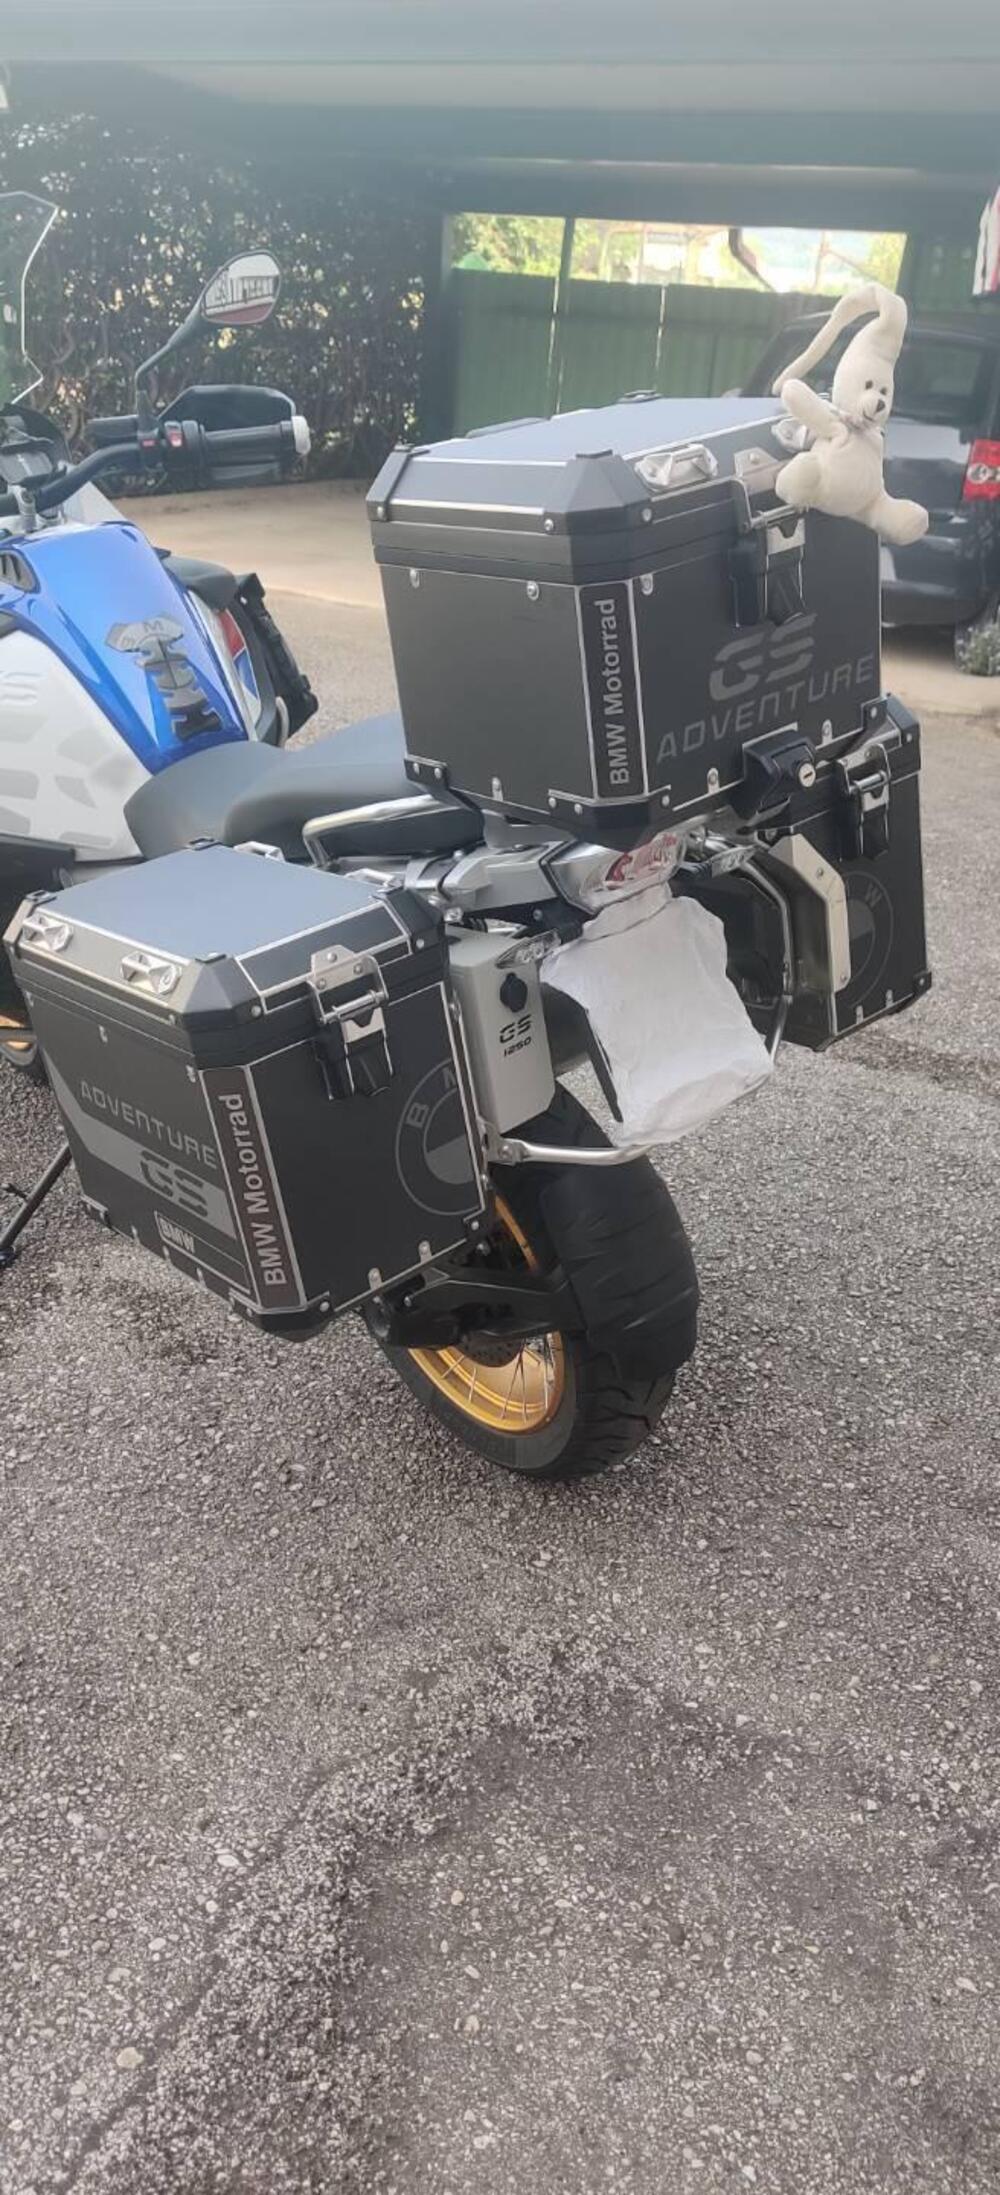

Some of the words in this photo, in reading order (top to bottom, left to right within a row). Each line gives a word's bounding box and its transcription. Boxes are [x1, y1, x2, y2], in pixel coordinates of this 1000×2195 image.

[594, 599, 625, 717] Motorrad
[709, 613, 817, 701] GS
[656, 654, 873, 764] ADVENTURE
[603, 723, 630, 785] BMW
[500, 1014, 532, 1043] GS
[503, 1037, 532, 1057] 1250
[80, 1081, 217, 1169] ADVENTURE
[219, 1094, 270, 1214] Motorrad
[140, 1150, 208, 1218] GS
[160, 1217, 195, 1253] BMW
[250, 1222, 287, 1286] BMW
